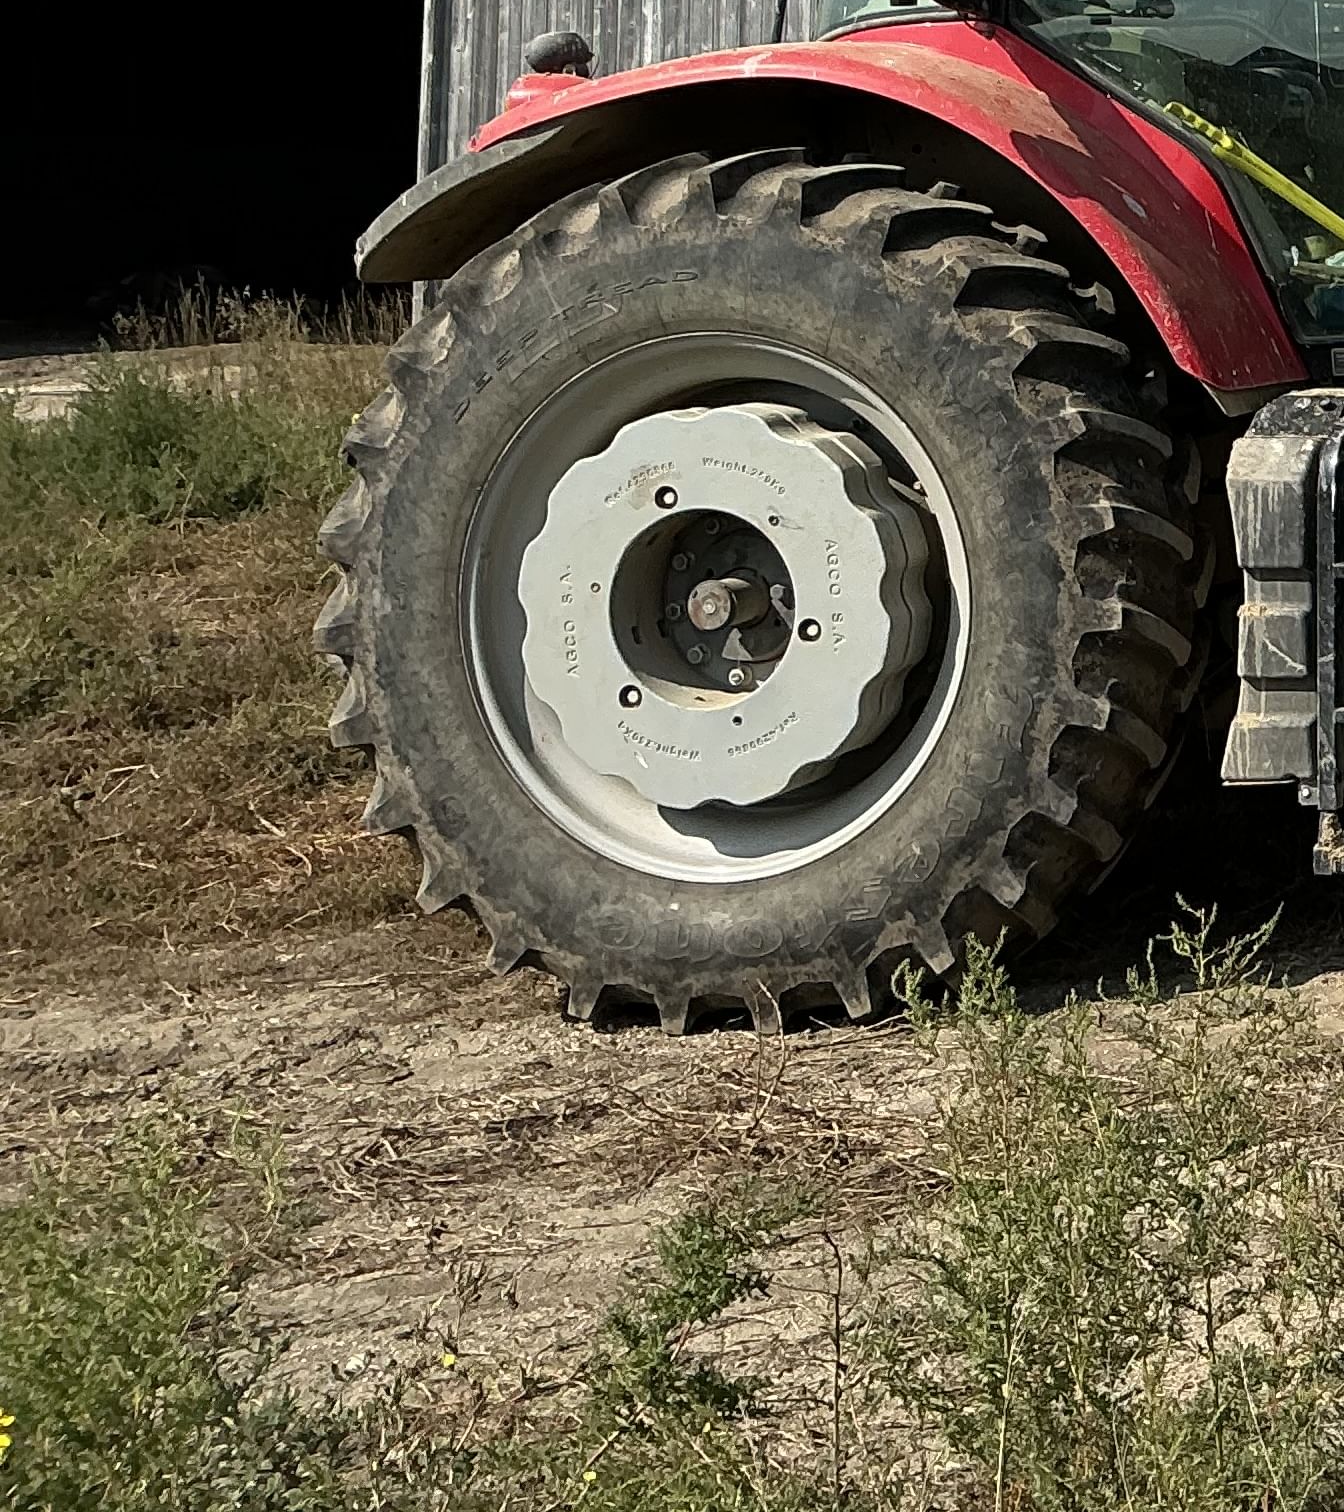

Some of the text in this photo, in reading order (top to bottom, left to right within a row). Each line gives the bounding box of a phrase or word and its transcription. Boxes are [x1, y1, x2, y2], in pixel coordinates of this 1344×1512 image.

[453, 328, 539, 425] DEEP
[559, 564, 580, 678] AGCO S.A.
[824, 539, 847, 655] AGCO S.A.
[597, 686, 1034, 962] Firestone
